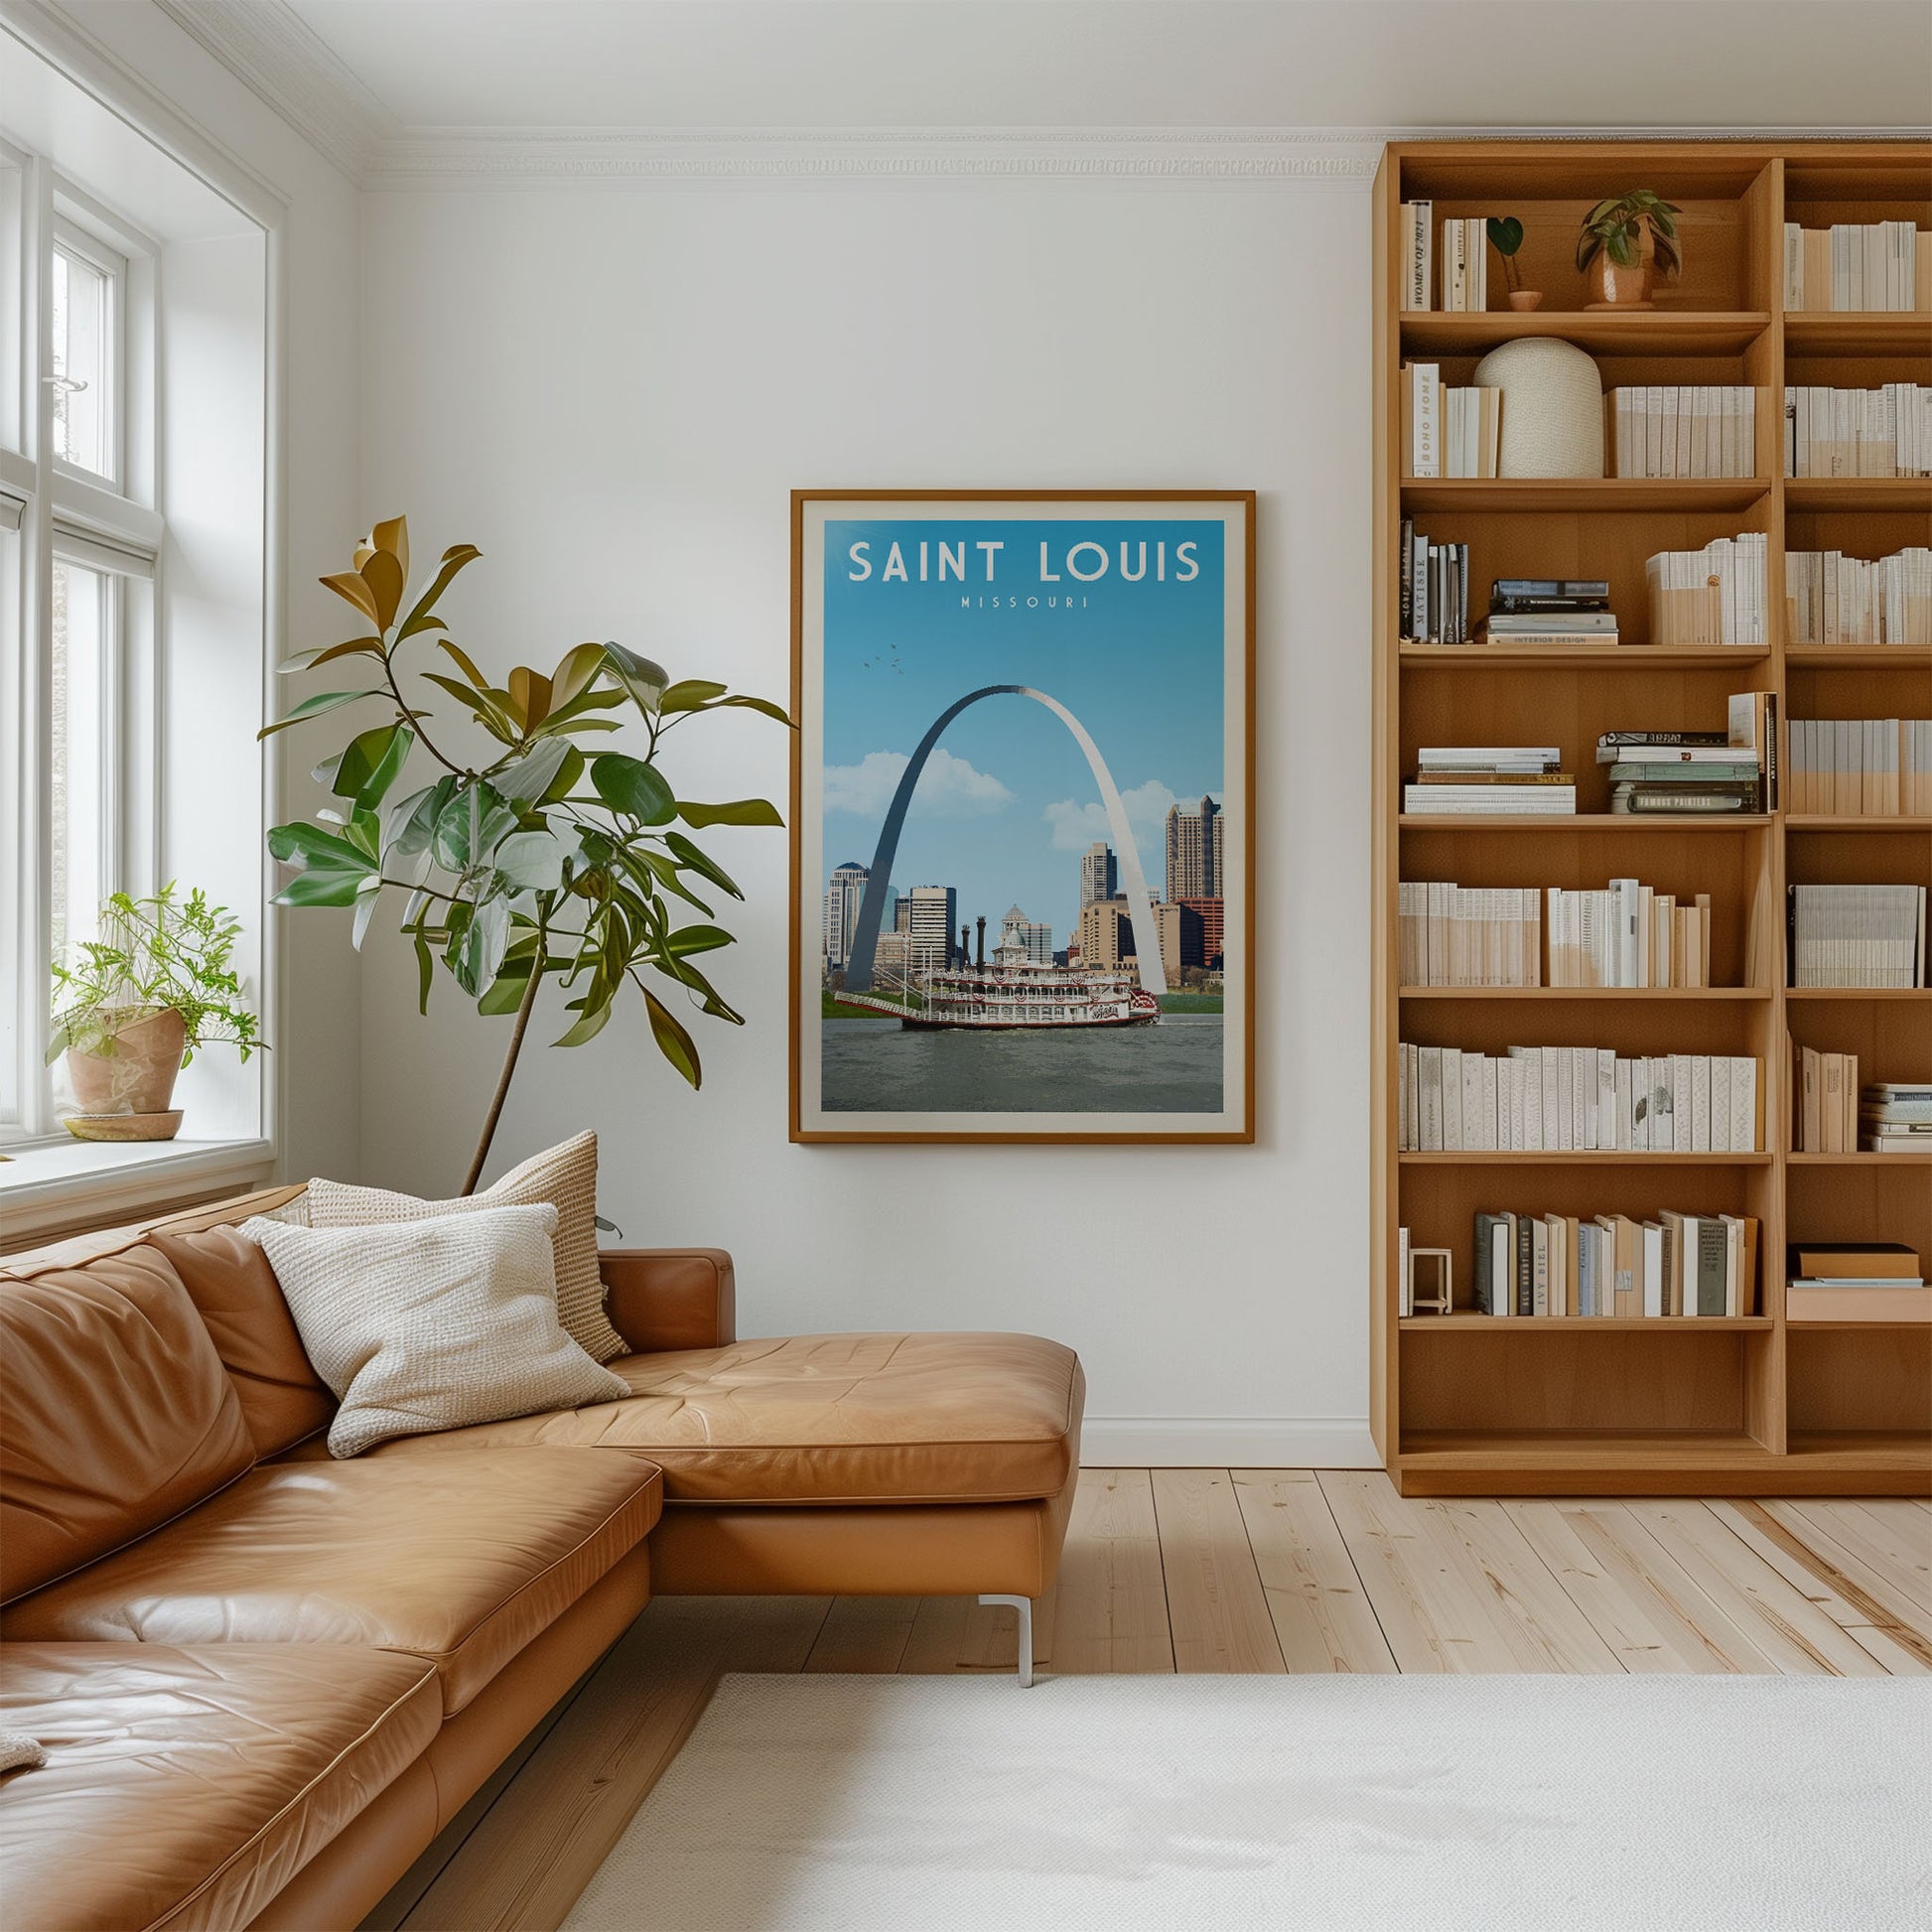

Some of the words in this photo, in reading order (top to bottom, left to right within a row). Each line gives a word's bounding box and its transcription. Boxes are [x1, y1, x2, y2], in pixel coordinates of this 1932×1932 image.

[1415, 244, 1424, 260] OF
[1422, 374, 1431, 415] HOME
[1422, 422, 1431, 462] BOHO
[849, 541, 1005, 582] SAINT
[1040, 541, 1200, 582] LOUIS
[961, 596, 1088, 609] MISSOURI
[1416, 559, 1425, 624] MATISSE
[1639, 797, 1671, 806] FAMOUS
[1674, 797, 1711, 806] PAINTERS
